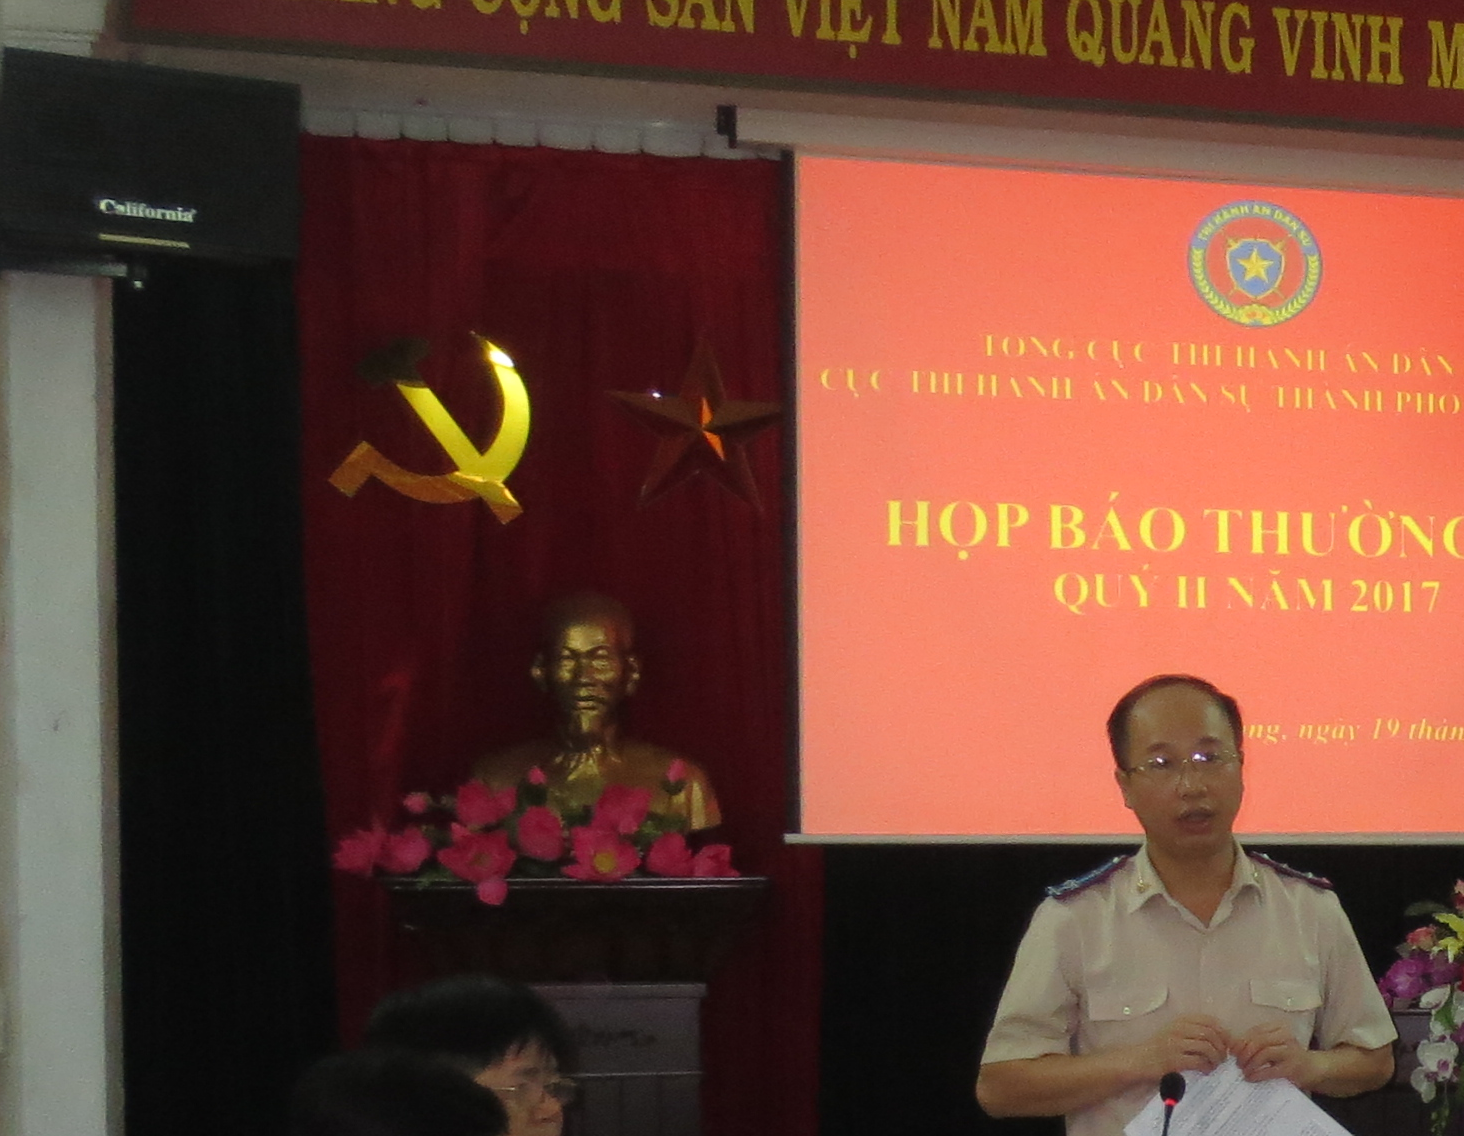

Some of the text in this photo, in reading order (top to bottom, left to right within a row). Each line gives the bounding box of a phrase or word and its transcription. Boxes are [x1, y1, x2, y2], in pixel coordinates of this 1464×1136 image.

[928, 0, 1048, 56] NAM
[1066, 0, 1256, 75] QUANG
[1274, 8, 1404, 86] VINH
[99, 198, 193, 222] California
[886, 500, 1030, 561] HỌP
[1048, 491, 1187, 553] BÁO
[1053, 563, 1441, 615] QUÝ II NĂM 2017
[1373, 717, 1400, 740] 19
